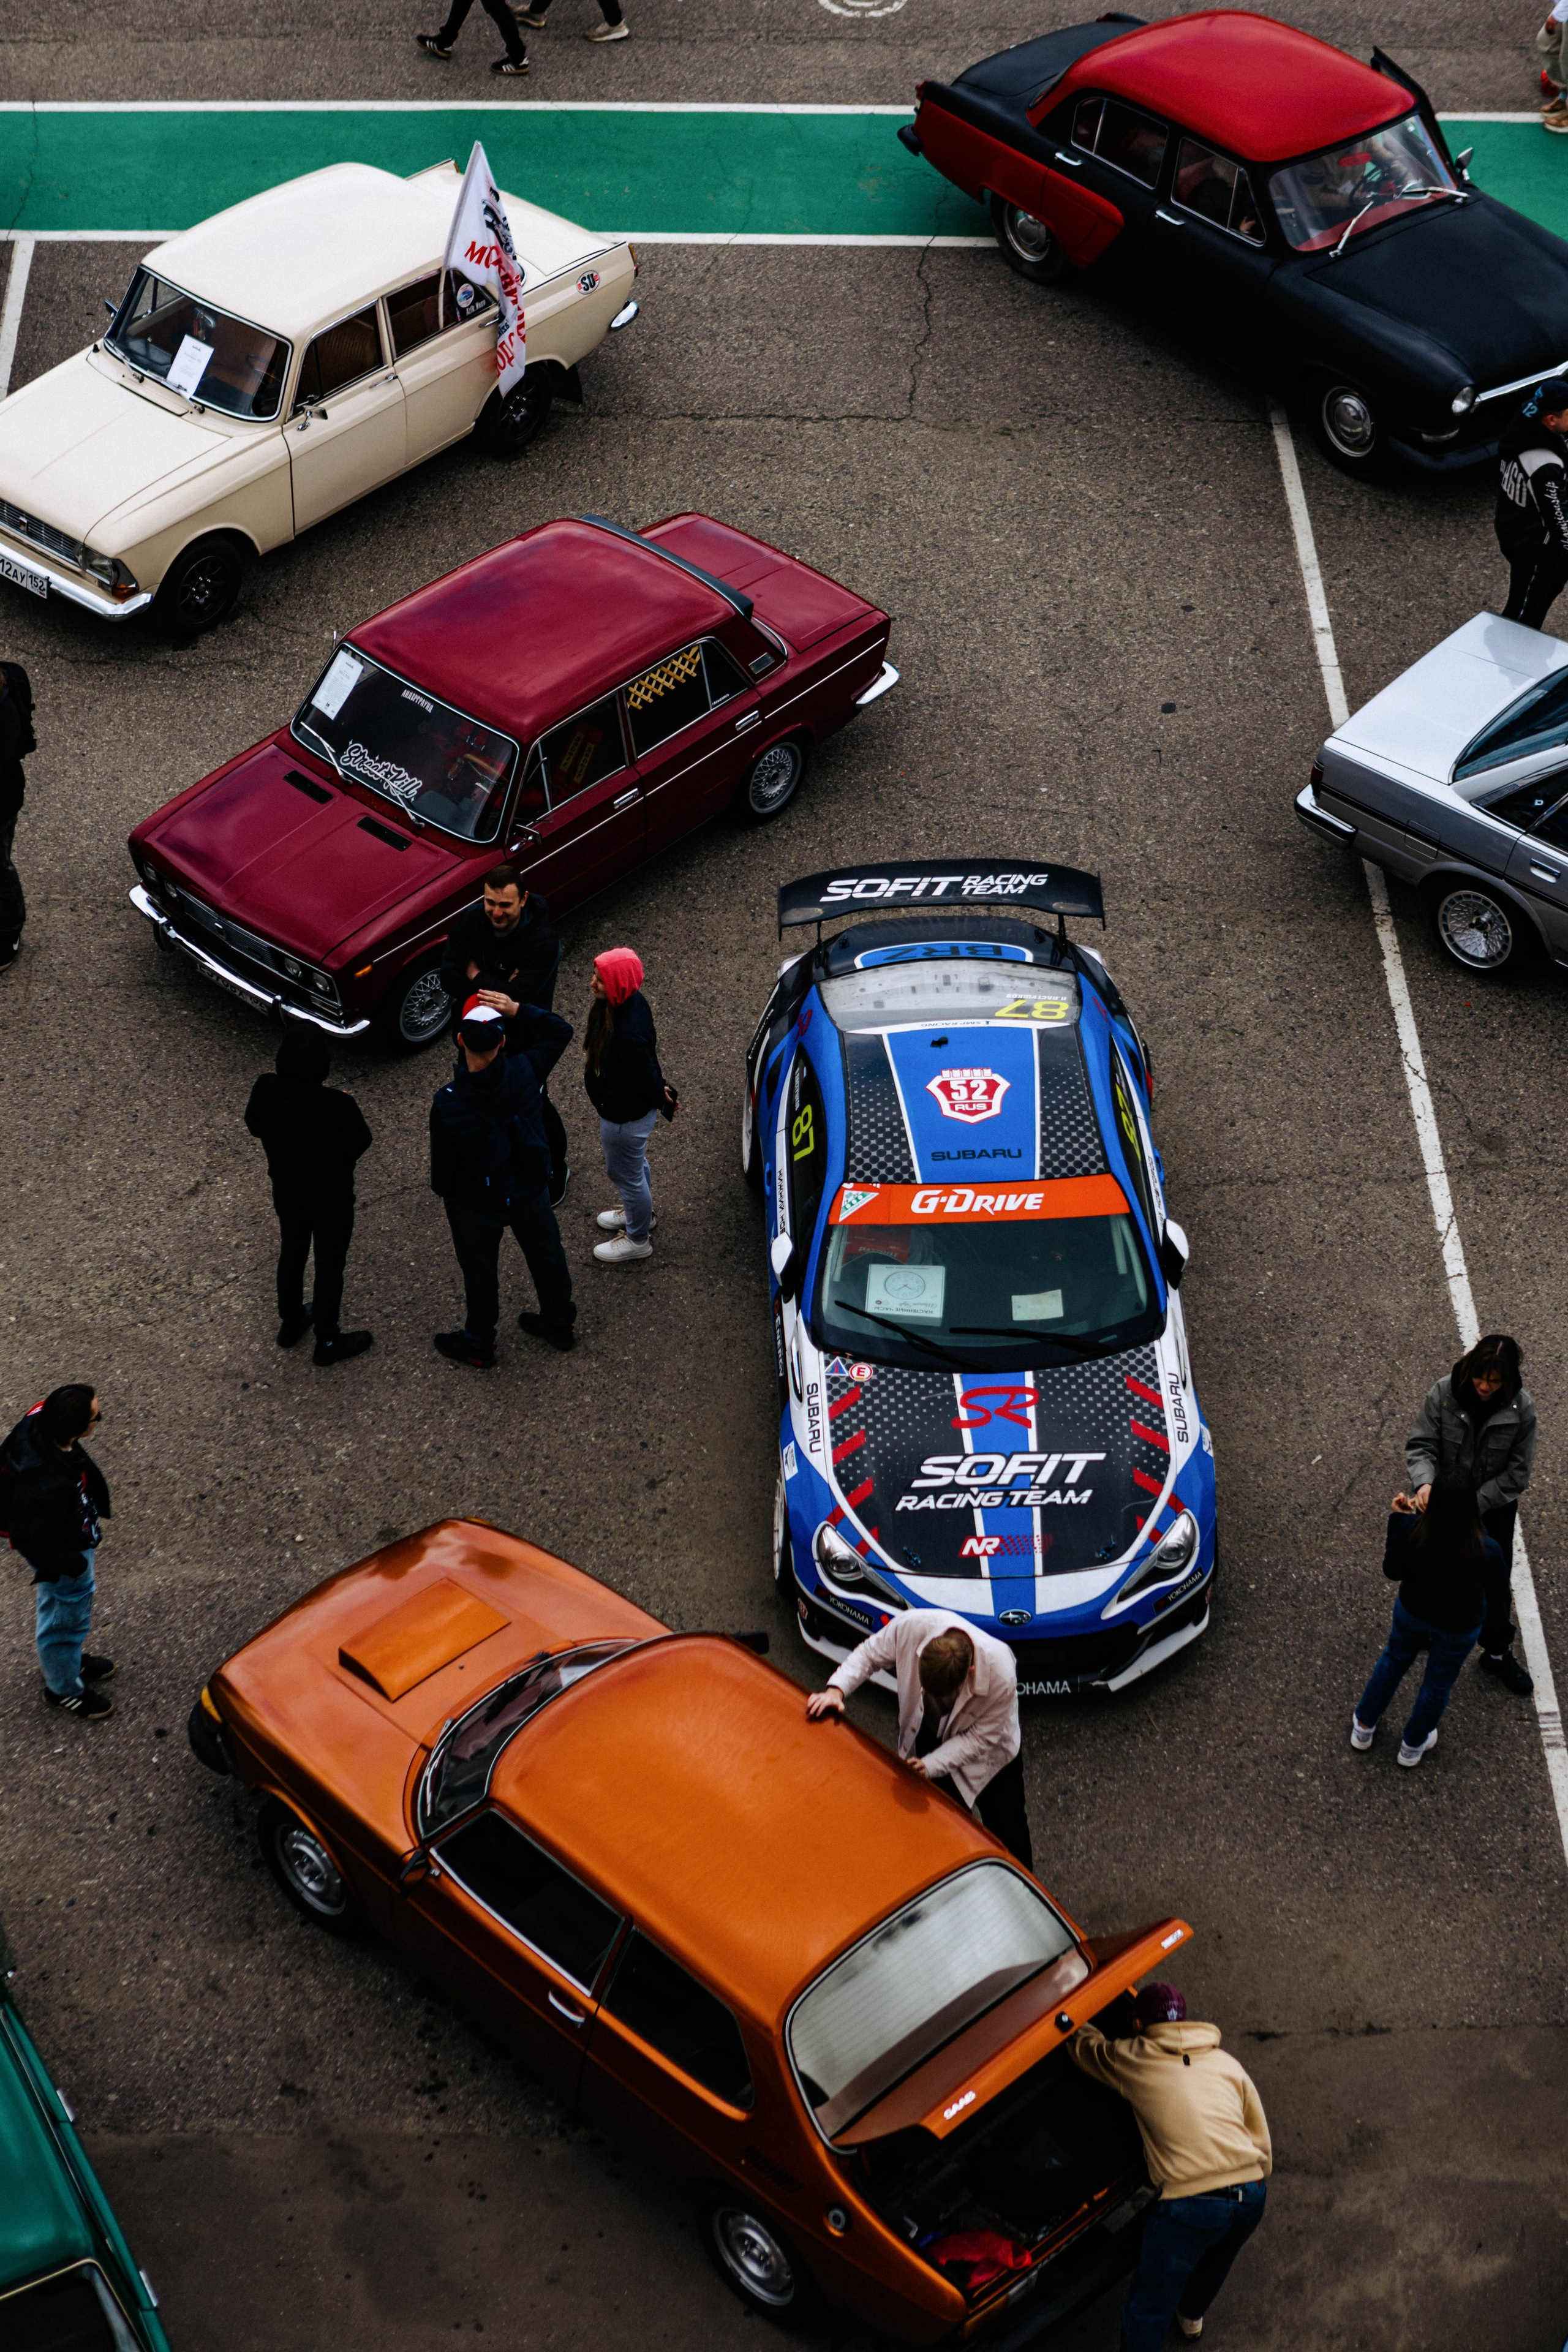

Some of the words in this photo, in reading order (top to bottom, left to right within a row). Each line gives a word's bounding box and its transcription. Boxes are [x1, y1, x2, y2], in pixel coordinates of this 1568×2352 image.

[580, 273, 597, 292] SU
[1522, 402, 1539, 418] 12
[401, 689, 433, 714] АНДЕРГРАУНД
[820, 875, 966, 902] SOFIT
[960, 884, 1027, 896] TEAM
[962, 873, 1048, 887] RACING
[880, 945, 1003, 960] BRZ
[994, 998, 1069, 1020] 87
[949, 1078, 989, 1101] 52
[954, 1102, 987, 1111] RUS
[793, 1104, 815, 1162] 87
[930, 1148, 1022, 1162] SUBARU
[911, 1189, 1044, 1215] G-DRIVE
[856, 1366, 866, 1376] E
[806, 1382, 821, 1453] SUBARU
[1175, 1373, 1189, 1443] SUBARU
[911, 1452, 1107, 1488] SOFIT
[895, 1490, 1004, 1512] RACING
[1008, 1488, 1093, 1508] TEAM
[962, 1537, 1000, 1556] NR
[1167, 1570, 1202, 1602] YOKOHAMA
[829, 1595, 870, 1626] YOKOHAMA
[943, 2090, 977, 2120] SAAB
